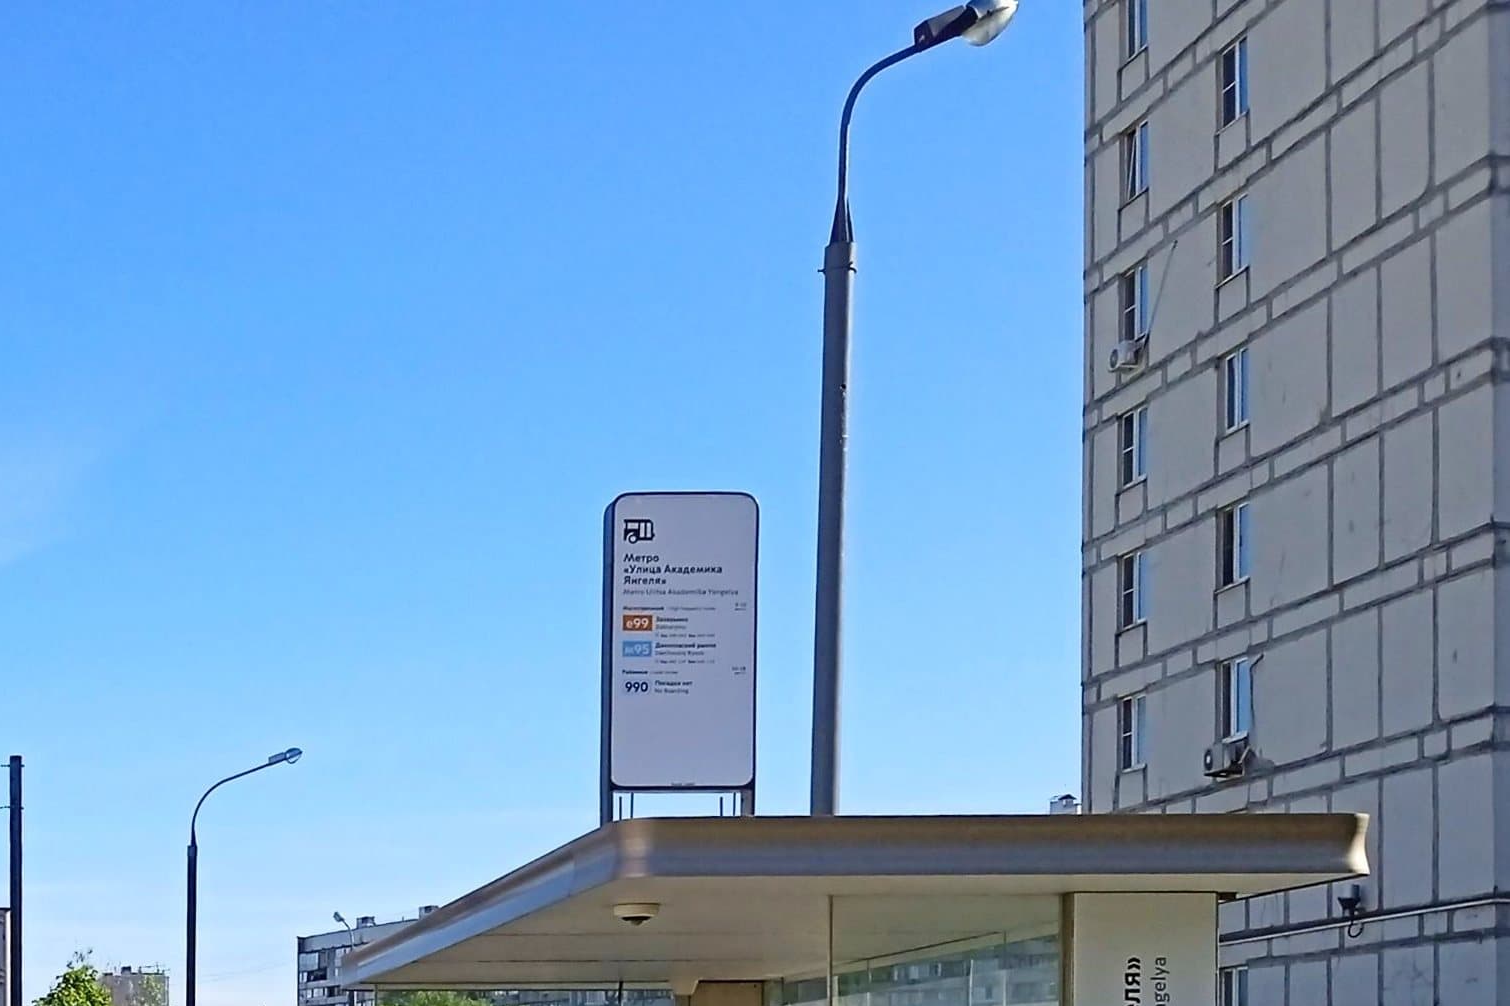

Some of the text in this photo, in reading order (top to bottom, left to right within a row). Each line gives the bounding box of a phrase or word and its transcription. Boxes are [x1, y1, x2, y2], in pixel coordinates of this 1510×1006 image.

[623, 553, 660, 564] Метро
[623, 564, 723, 575] «Улица Академика
[623, 576, 667, 585] Янгеля»
[625, 681, 649, 693] 990
